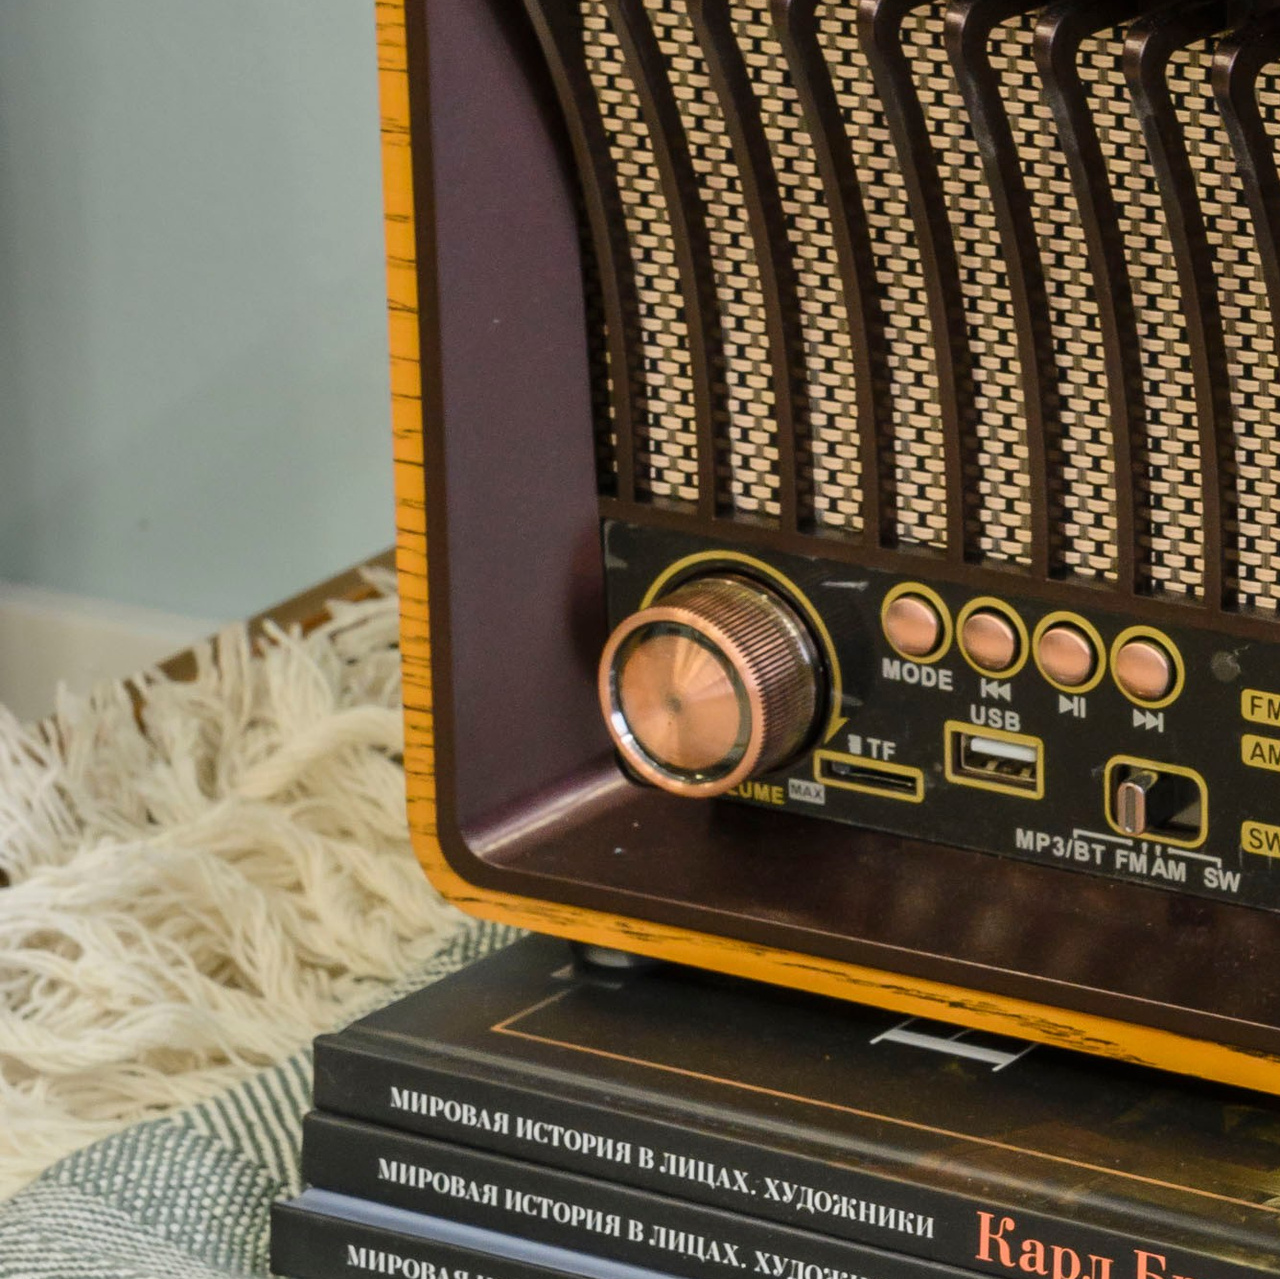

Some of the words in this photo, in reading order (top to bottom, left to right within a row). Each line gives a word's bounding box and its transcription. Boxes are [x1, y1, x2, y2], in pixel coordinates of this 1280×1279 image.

[882, 658, 954, 692] MODE
[969, 704, 1022, 732] USB
[867, 736, 897, 761] TF
[1015, 827, 1106, 865] MP3/BT
[1114, 848, 1148, 875] FM
[1151, 856, 1187, 883] AM
[1203, 866, 1241, 894] SW
[390, 1086, 510, 1135] МИРОВАЯ
[515, 1116, 632, 1165] ИСТОРИЯ
[638, 1146, 655, 1170] В
[659, 1152, 757, 1196] ЛИЦАХ.
[764, 1177, 935, 1239] ХУДОЖНИКИ
[378, 1157, 499, 1207] МИРОВАЯ
[504, 1188, 622, 1238] ИСТОРИЯ
[628, 1219, 645, 1243] В
[649, 1225, 747, 1269] ЛИЦАХ.
